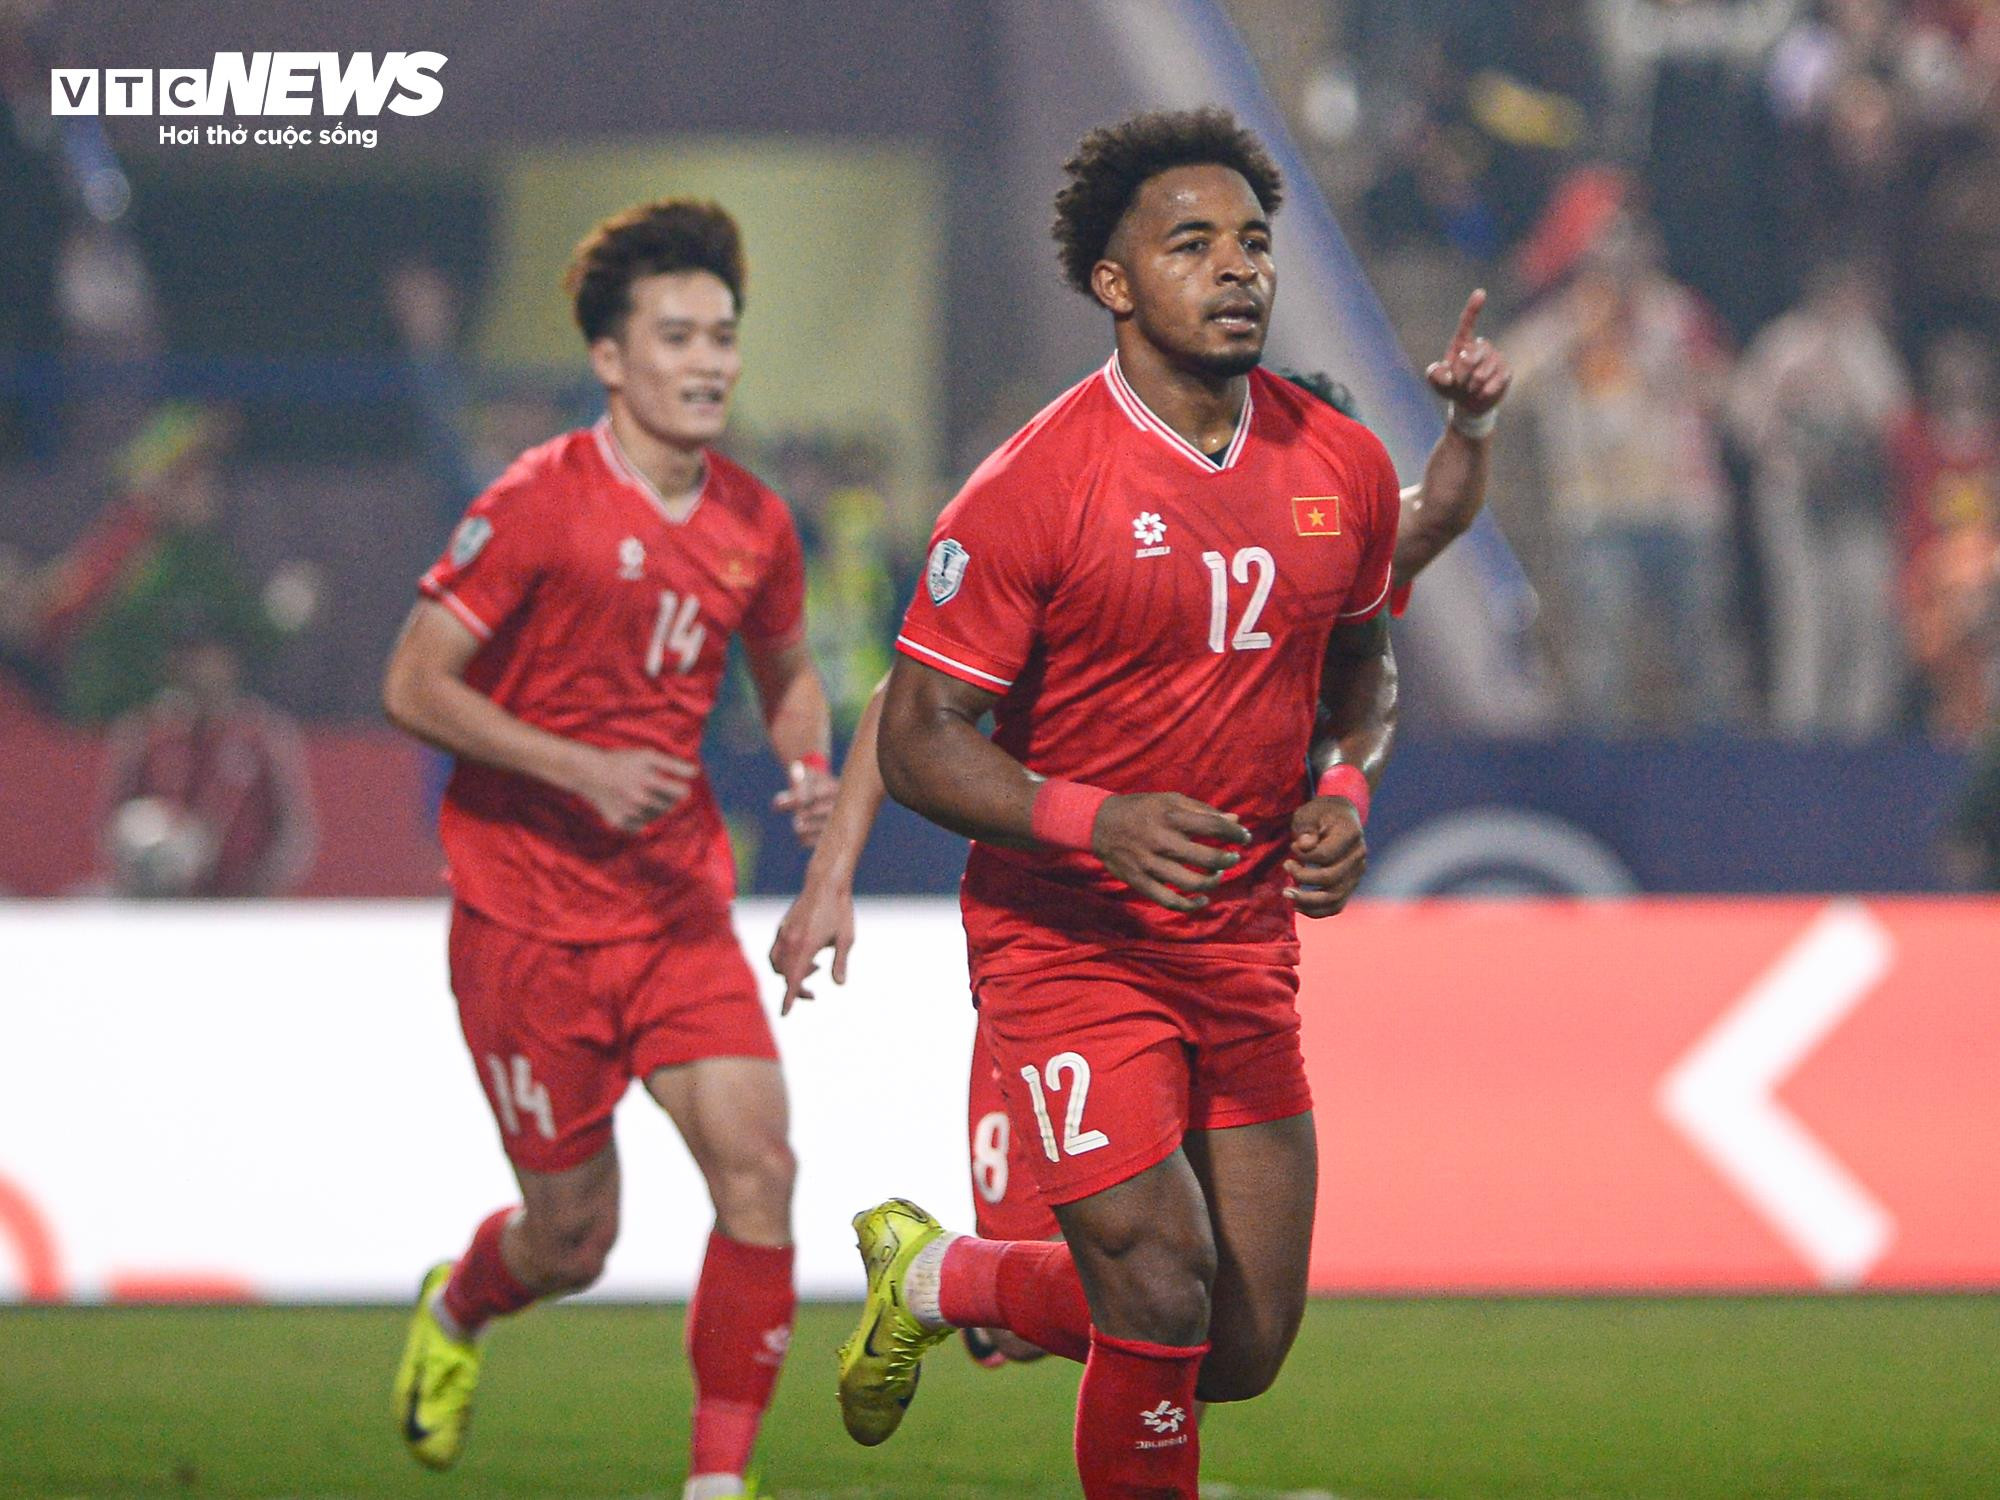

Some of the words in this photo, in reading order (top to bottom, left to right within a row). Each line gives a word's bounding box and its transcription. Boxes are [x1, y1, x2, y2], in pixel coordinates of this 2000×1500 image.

[645, 590, 707, 678] 14
[1202, 546, 1276, 653] 12
[485, 1053, 557, 1139] 14
[1020, 1051, 1109, 1162] 12
[974, 1111, 1010, 1203] 8
